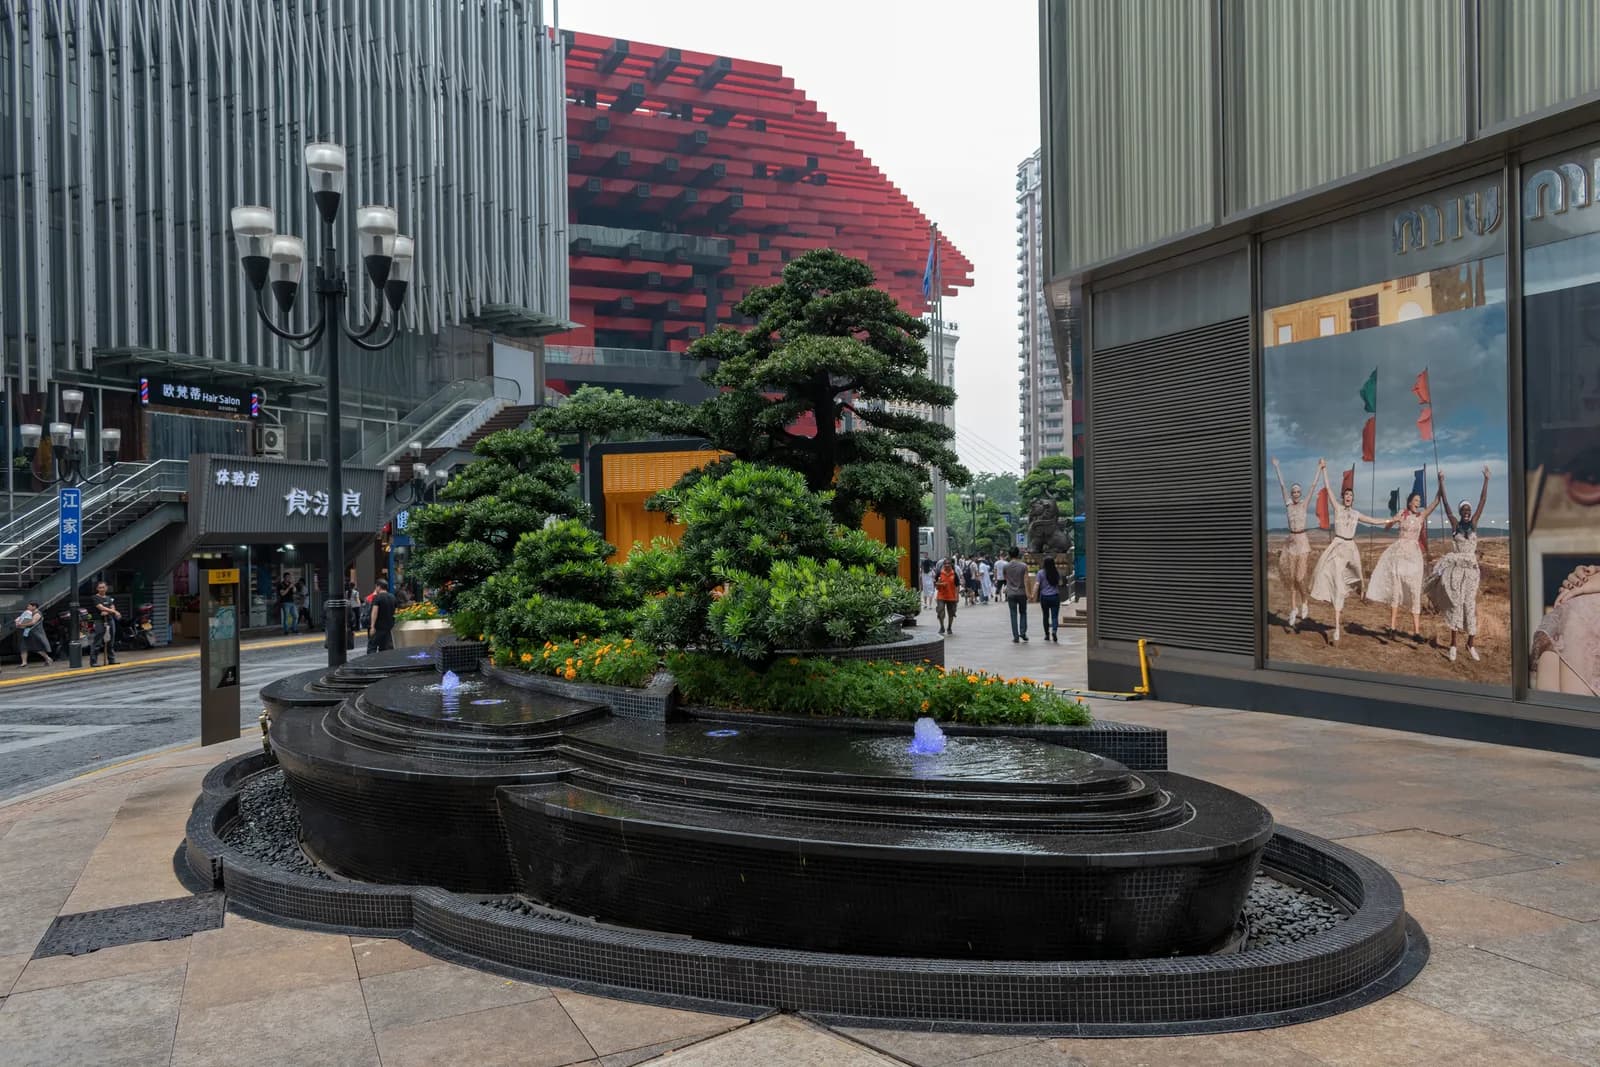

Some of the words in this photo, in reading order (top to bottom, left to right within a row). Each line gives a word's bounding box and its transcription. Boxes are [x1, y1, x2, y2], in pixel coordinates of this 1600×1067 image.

[1393, 186, 1502, 254] miu
[202, 392, 218, 404] Hair
[219, 394, 241, 406] Salon
[216, 469, 260, 487] 体验店
[63, 493, 78, 560] 江家巷
